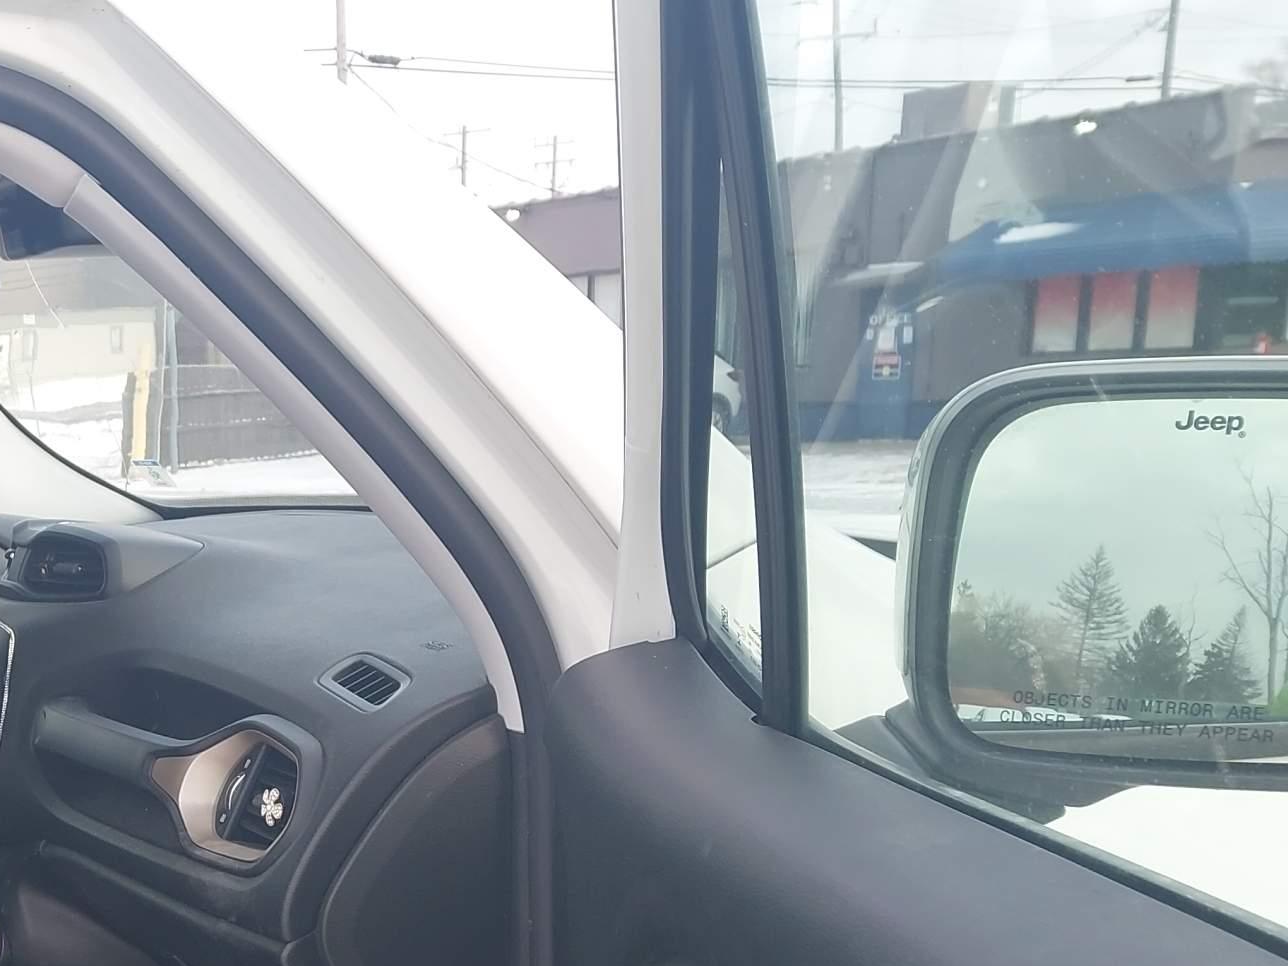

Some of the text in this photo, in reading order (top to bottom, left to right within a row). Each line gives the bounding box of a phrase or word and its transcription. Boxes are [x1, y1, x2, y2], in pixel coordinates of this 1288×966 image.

[1175, 410, 1245, 436] Jeep
[1013, 690, 1265, 721] OBJECTS IN MIRROR ARE
[999, 709, 1274, 743] CLOSER THAN THEY APPEAR
